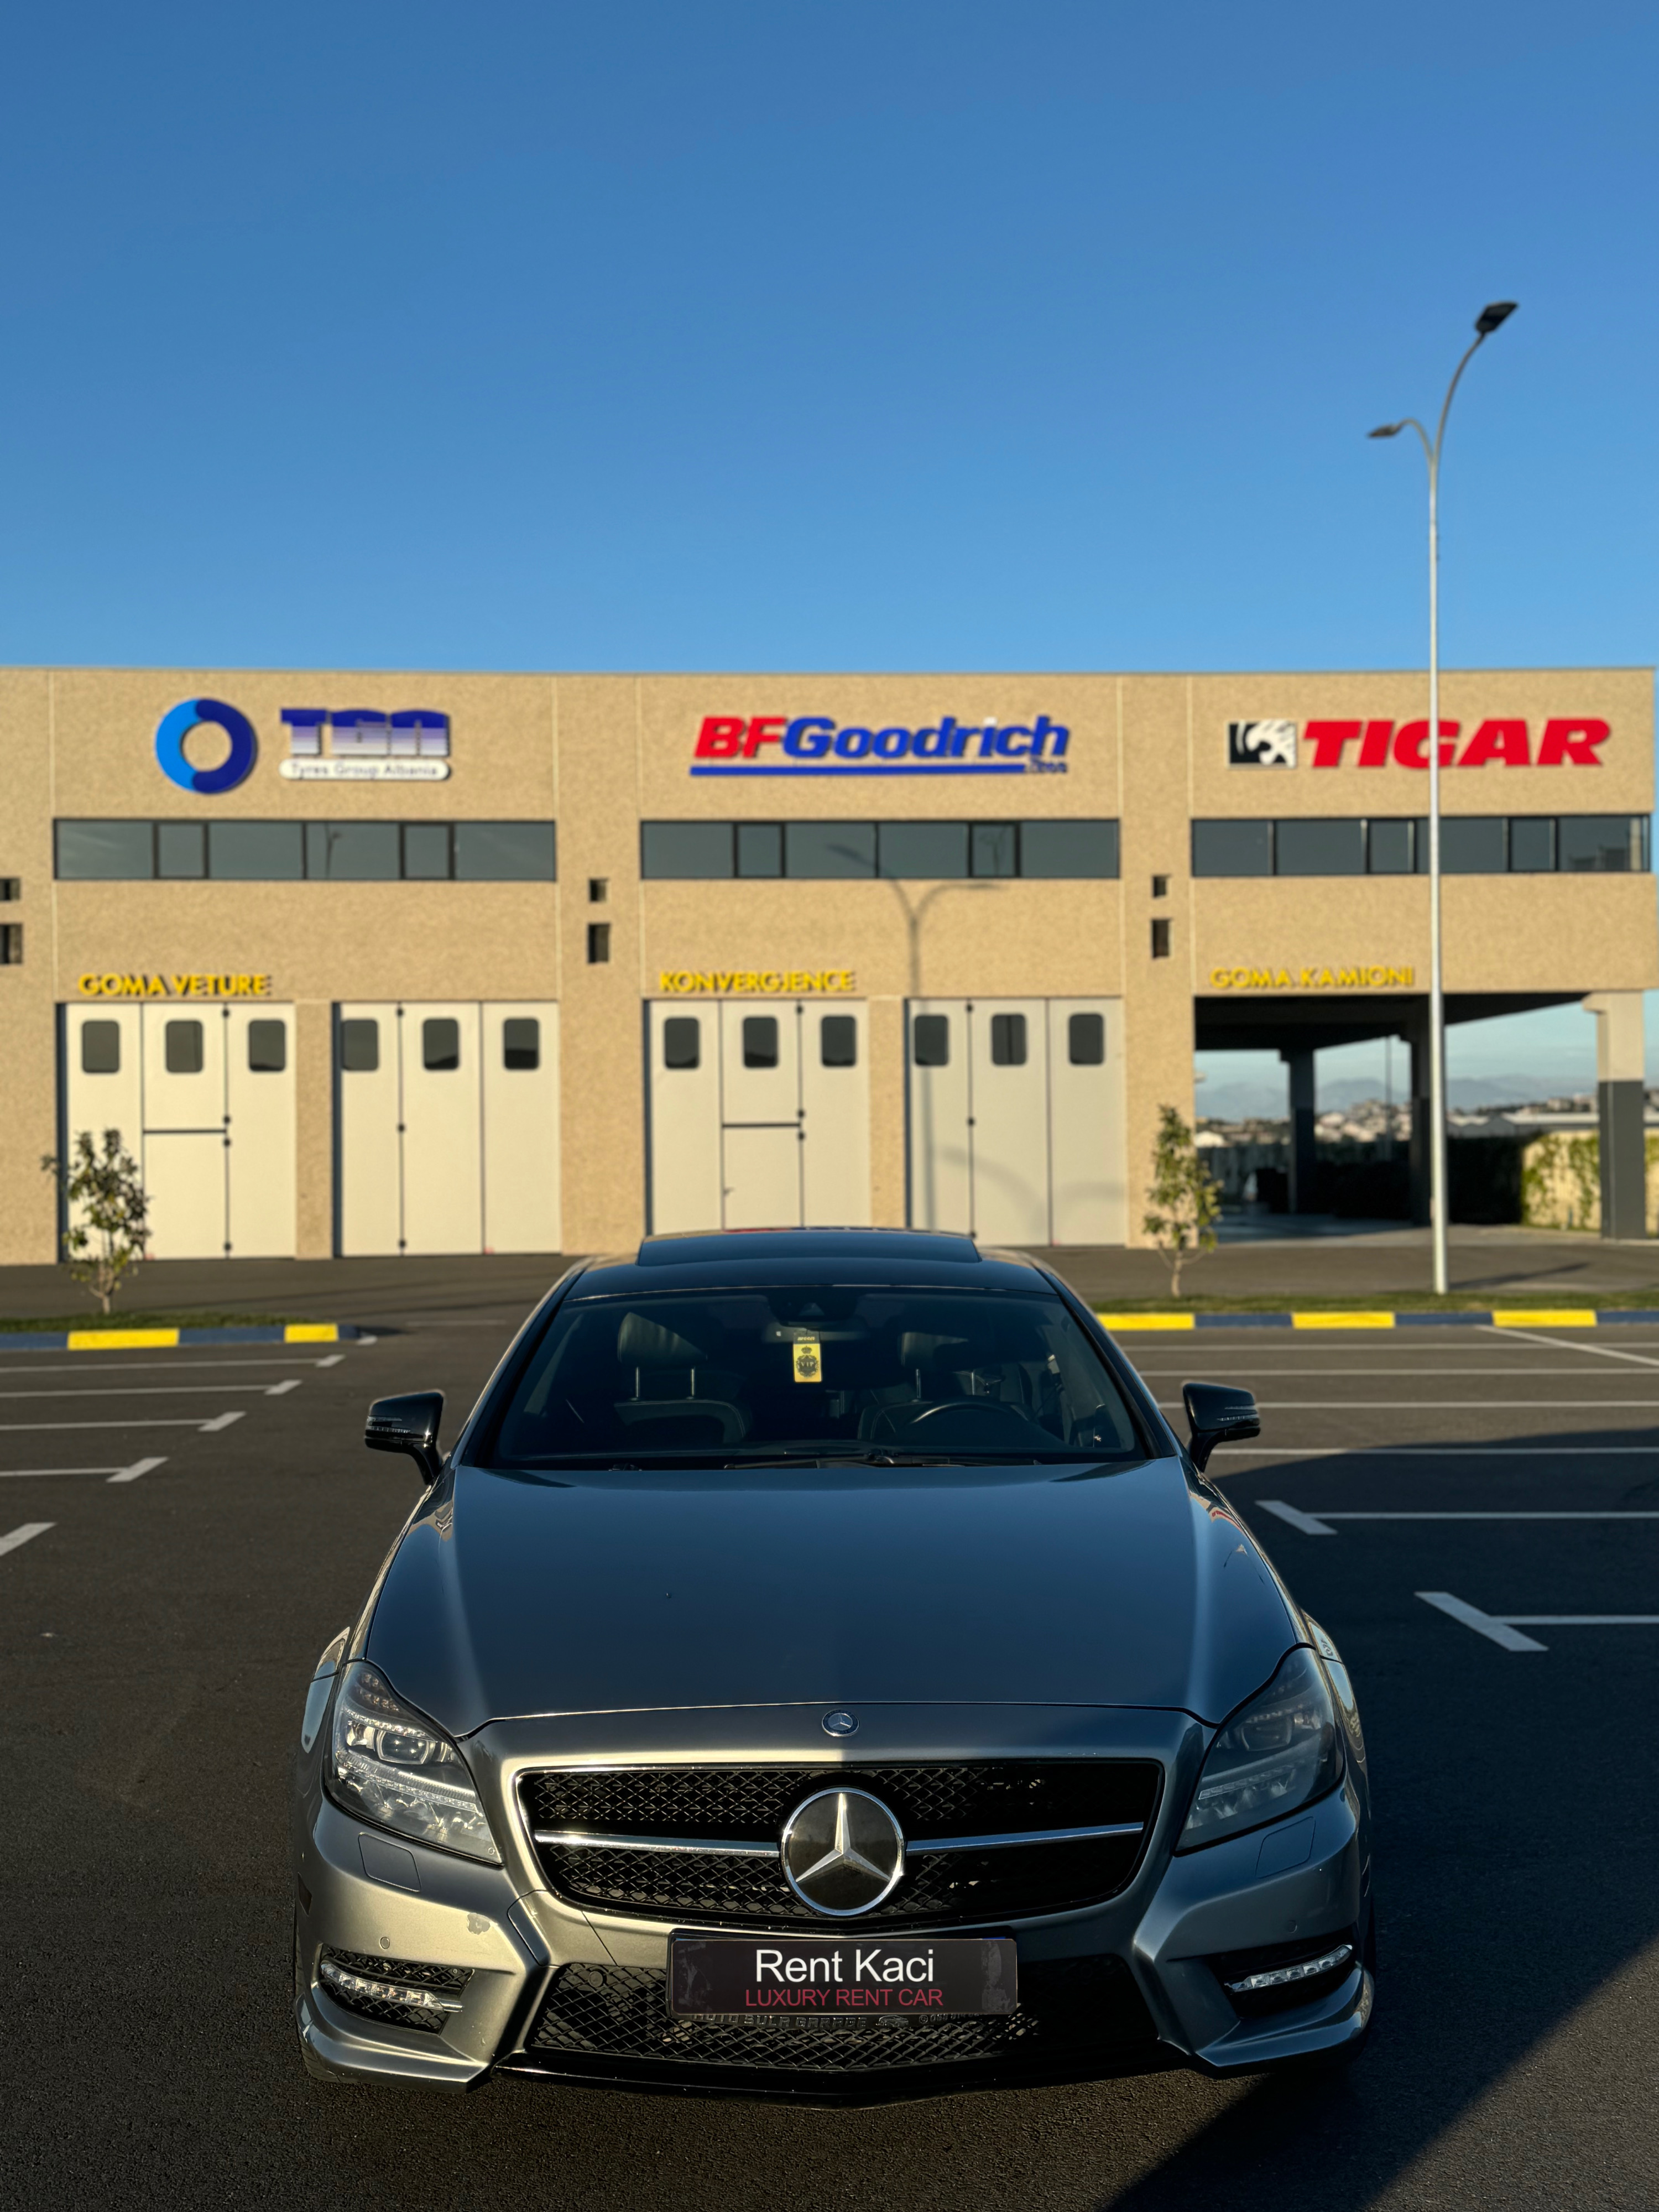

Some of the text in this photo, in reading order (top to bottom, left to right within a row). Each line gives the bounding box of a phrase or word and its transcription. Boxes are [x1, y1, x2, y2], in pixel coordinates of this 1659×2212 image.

[694, 715, 1070, 758] BFGoodrich
[1304, 718, 1610, 769] TIGAR
[291, 763, 437, 780] Tyres Group Albania
[79, 973, 269, 995] GOMA VETURE
[660, 970, 855, 992] KONVERGJENCE
[1210, 965, 1414, 988] GOMA KAMIONI
[756, 1949, 934, 1983] Rent Kaci
[745, 1989, 943, 2007] LUXURY RENT CAR
